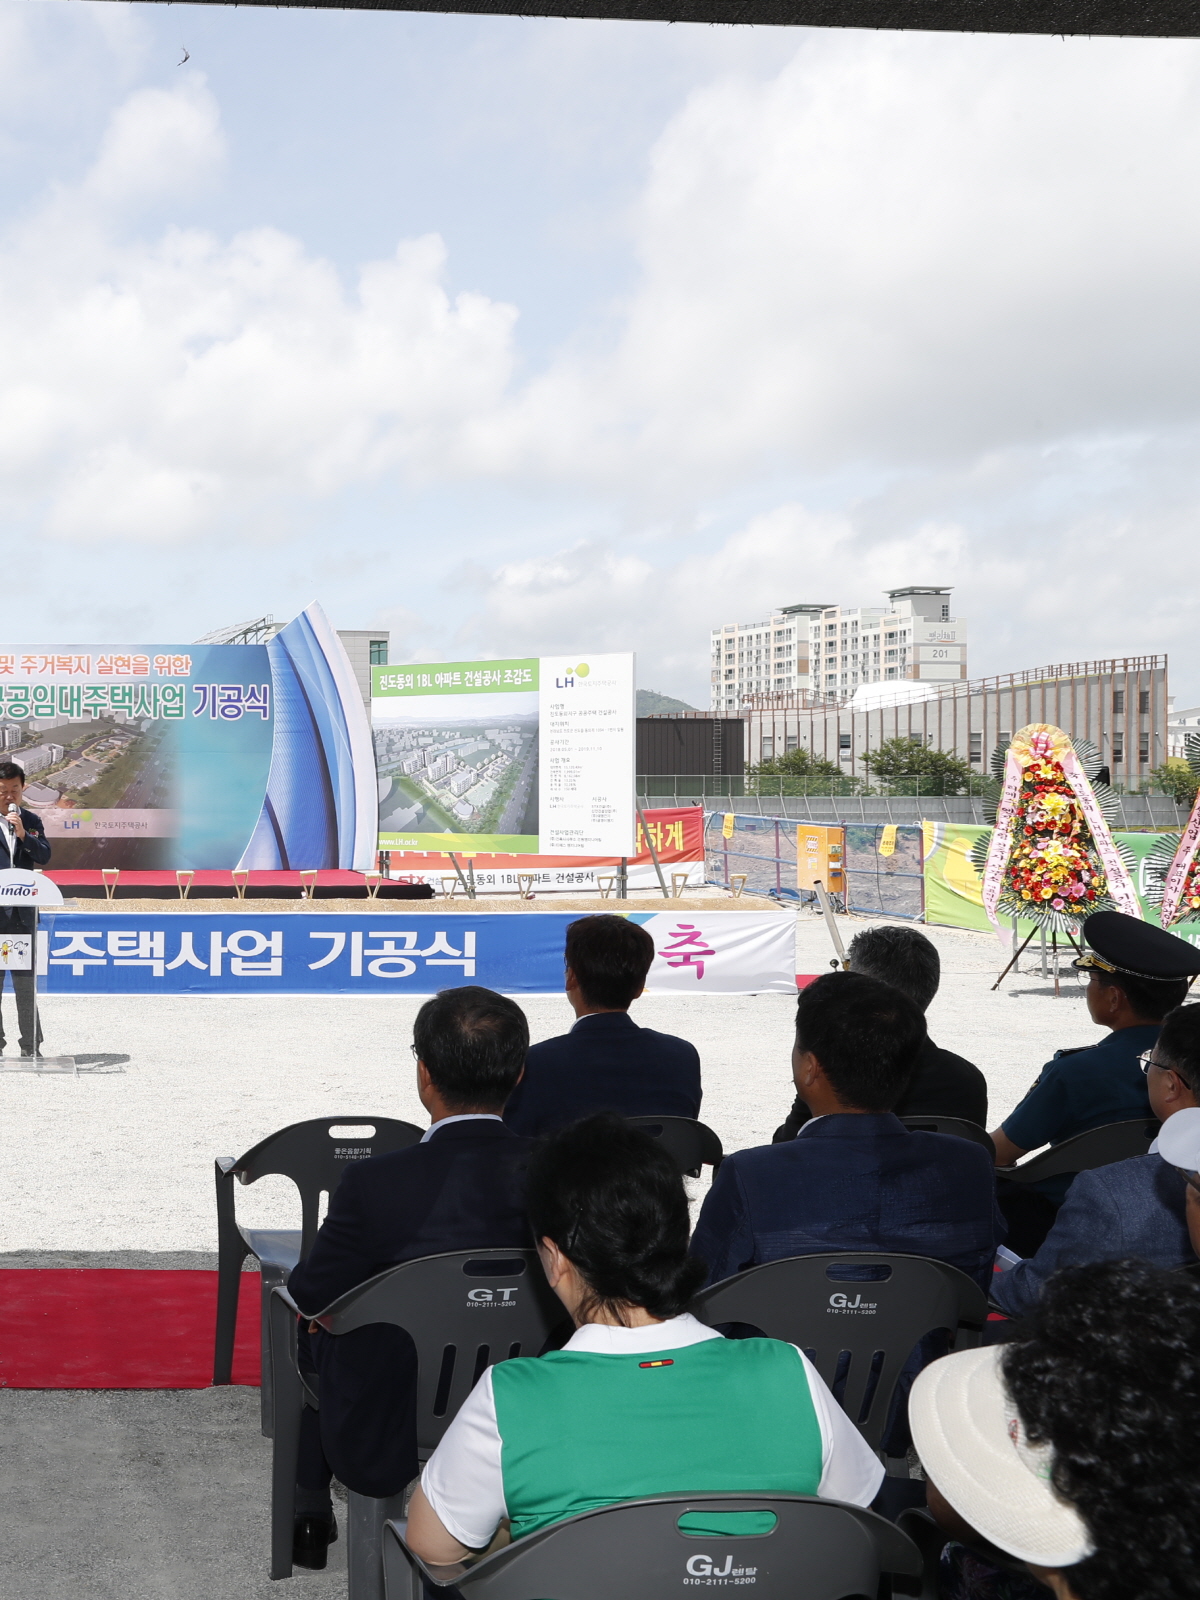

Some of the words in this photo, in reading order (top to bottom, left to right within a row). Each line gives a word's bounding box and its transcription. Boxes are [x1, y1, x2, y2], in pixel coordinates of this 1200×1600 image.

[933, 650, 948, 658] 201
[21, 655, 90, 674] 주거복지
[96, 655, 149, 674] 실현을
[154, 655, 191, 675] 위한
[380, 674, 414, 690] 진도동외
[417, 674, 432, 687] 1BL
[435, 672, 462, 688] 아파트
[464, 670, 501, 686] 건설공사
[503, 668, 532, 685] 조감도
[556, 677, 574, 688] LH
[193, 684, 269, 719] 기공식
[64, 821, 79, 829] LH
[95, 821, 148, 829] 한국토지주택공사
[555, 872, 594, 884] 건설공사
[308, 930, 476, 978] 기공식
[657, 923, 716, 980] 축
[467, 1287, 519, 1302] GT
[683, 1577, 756, 1585] 010-2111-5200
